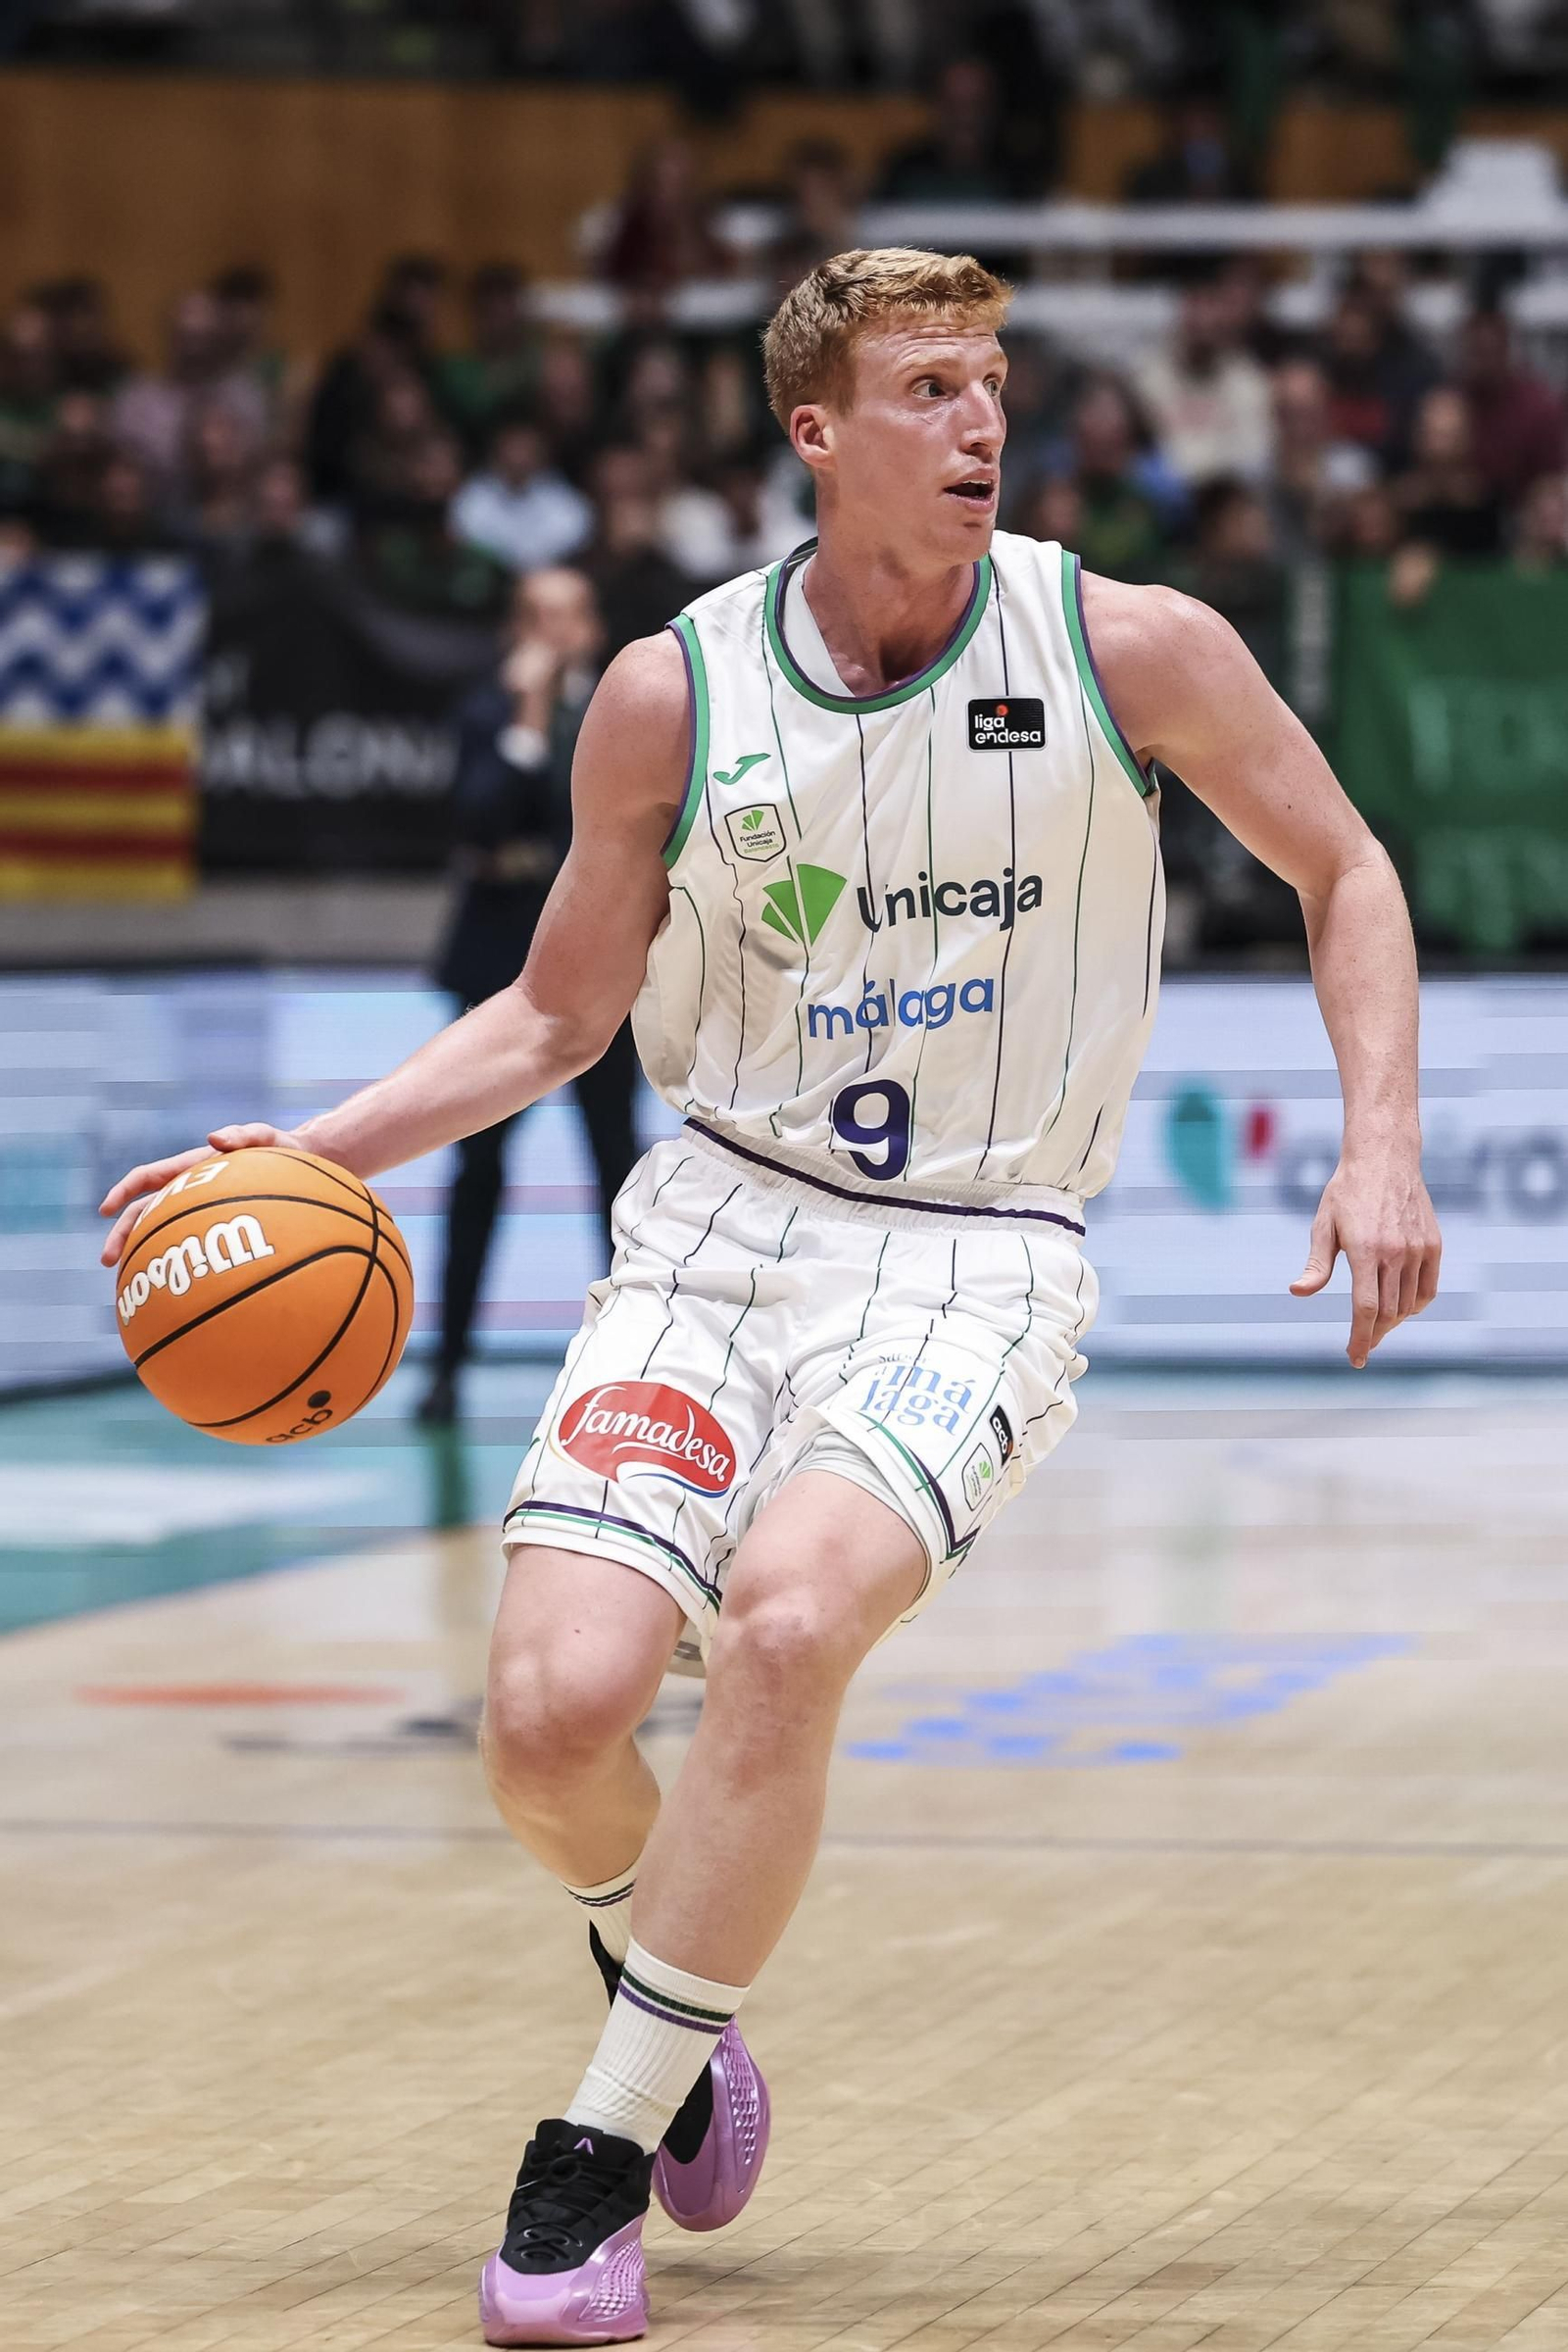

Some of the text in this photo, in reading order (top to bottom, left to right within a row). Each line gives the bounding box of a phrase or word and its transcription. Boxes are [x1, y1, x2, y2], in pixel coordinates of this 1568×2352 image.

[975, 713, 1005, 731] liga
[975, 728, 1042, 744] endesa
[739, 830, 776, 842] Fundación
[747, 838, 773, 848] Unicaja
[857, 867, 1043, 933] Unicaja
[808, 978, 994, 1040] málaga
[832, 1079, 910, 1180] 9
[118, 1213, 275, 1326] Wilson
[266, 1409, 333, 1444] acb
[560, 1386, 732, 1482] famadesa
[991, 1416, 1009, 1454] acb
